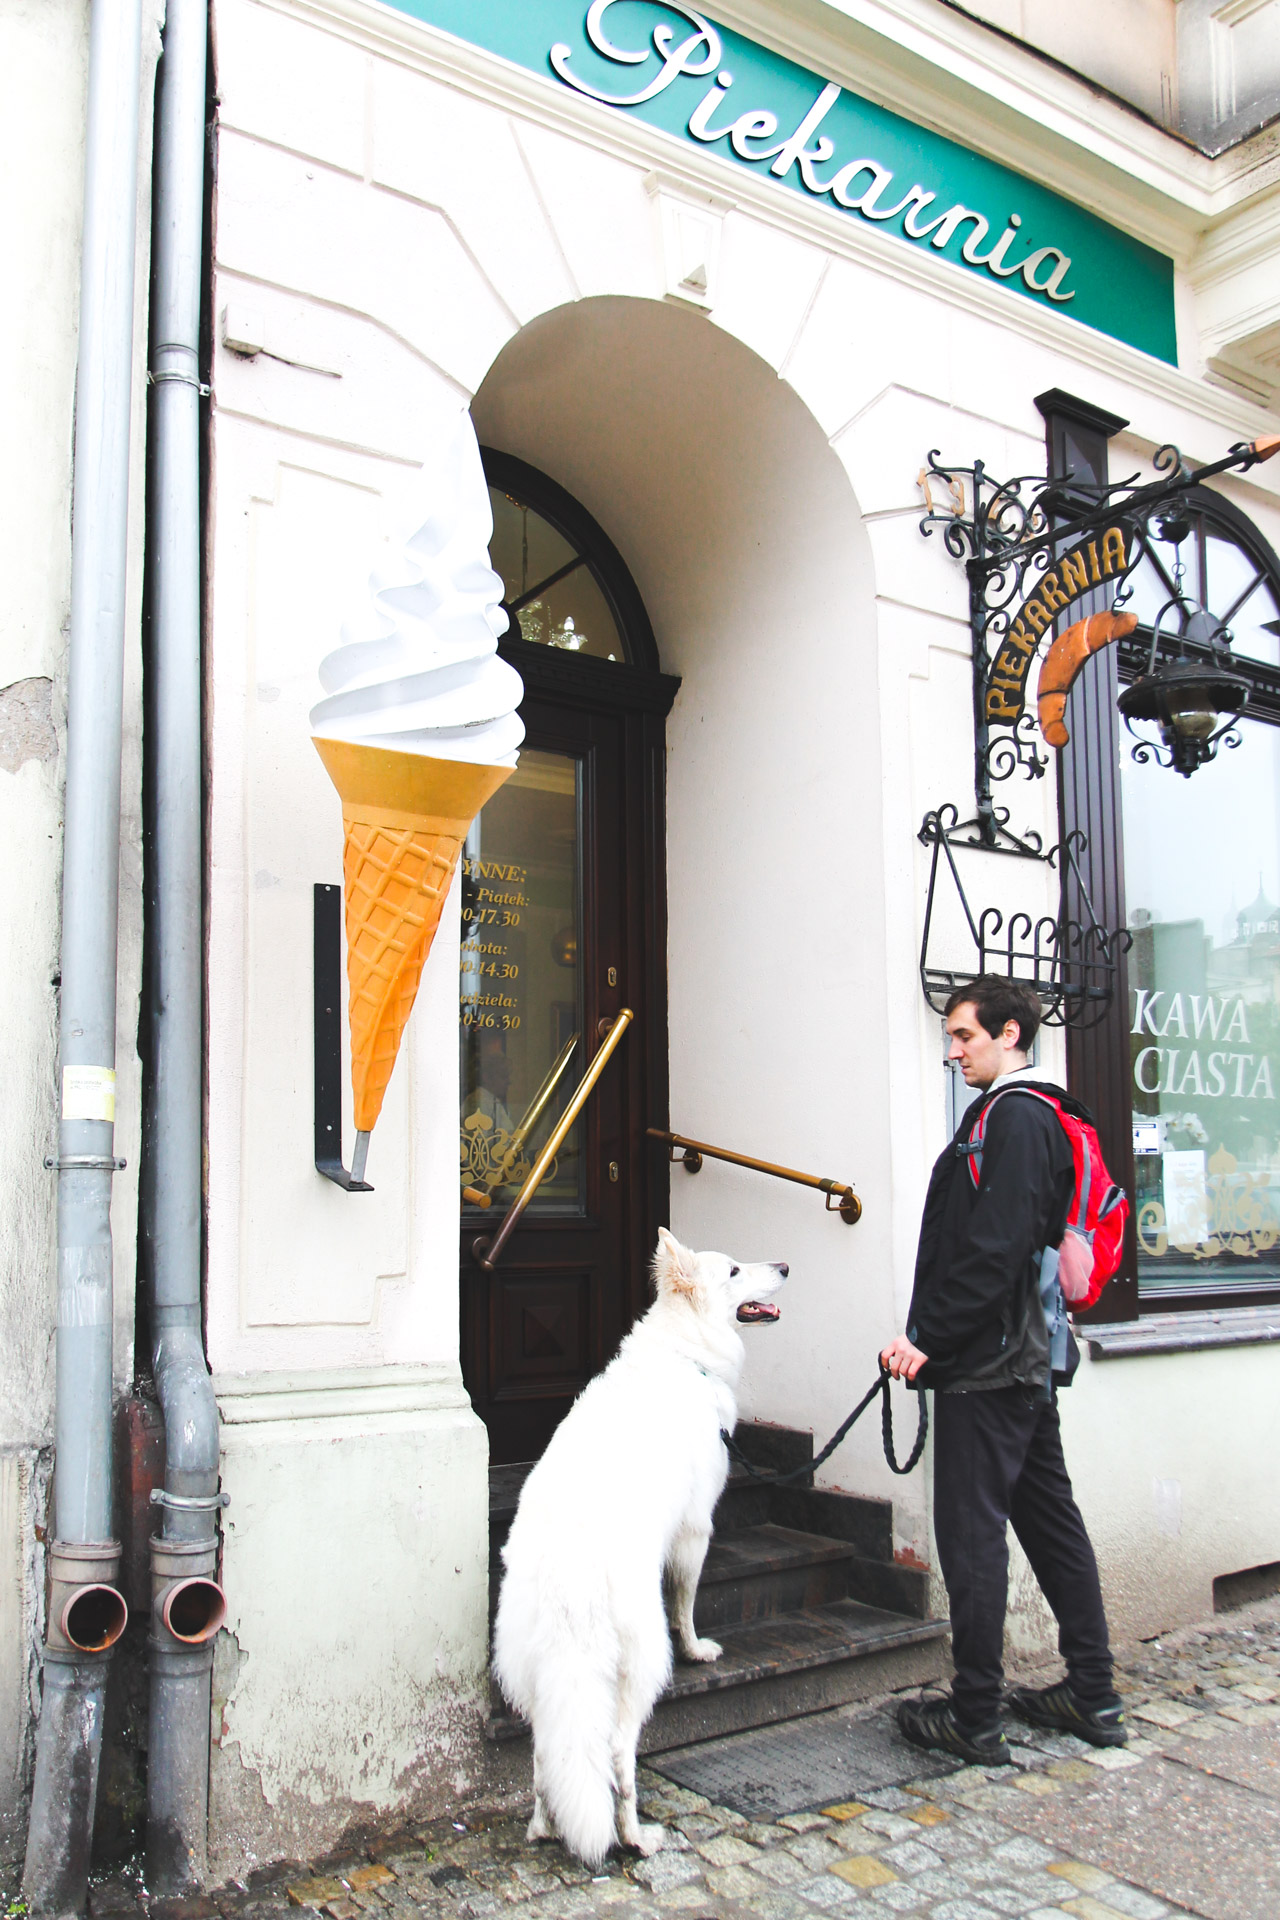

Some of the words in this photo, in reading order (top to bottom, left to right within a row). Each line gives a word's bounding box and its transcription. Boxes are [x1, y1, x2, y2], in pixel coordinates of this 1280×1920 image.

[549, 0, 1075, 301] Piekarnia
[986, 527, 1128, 719] PIEKARNIA
[463, 859, 527, 883] YNNE:
[477, 888, 530, 907] Piątek:
[461, 907, 520, 927] 0-17.30
[460, 939, 508, 955] obota:
[460, 992, 518, 1008] edziela:
[459, 1013, 521, 1031] 0-16.30
[1130, 988, 1251, 1043] KAWA
[1134, 1046, 1275, 1099] CIASTA
